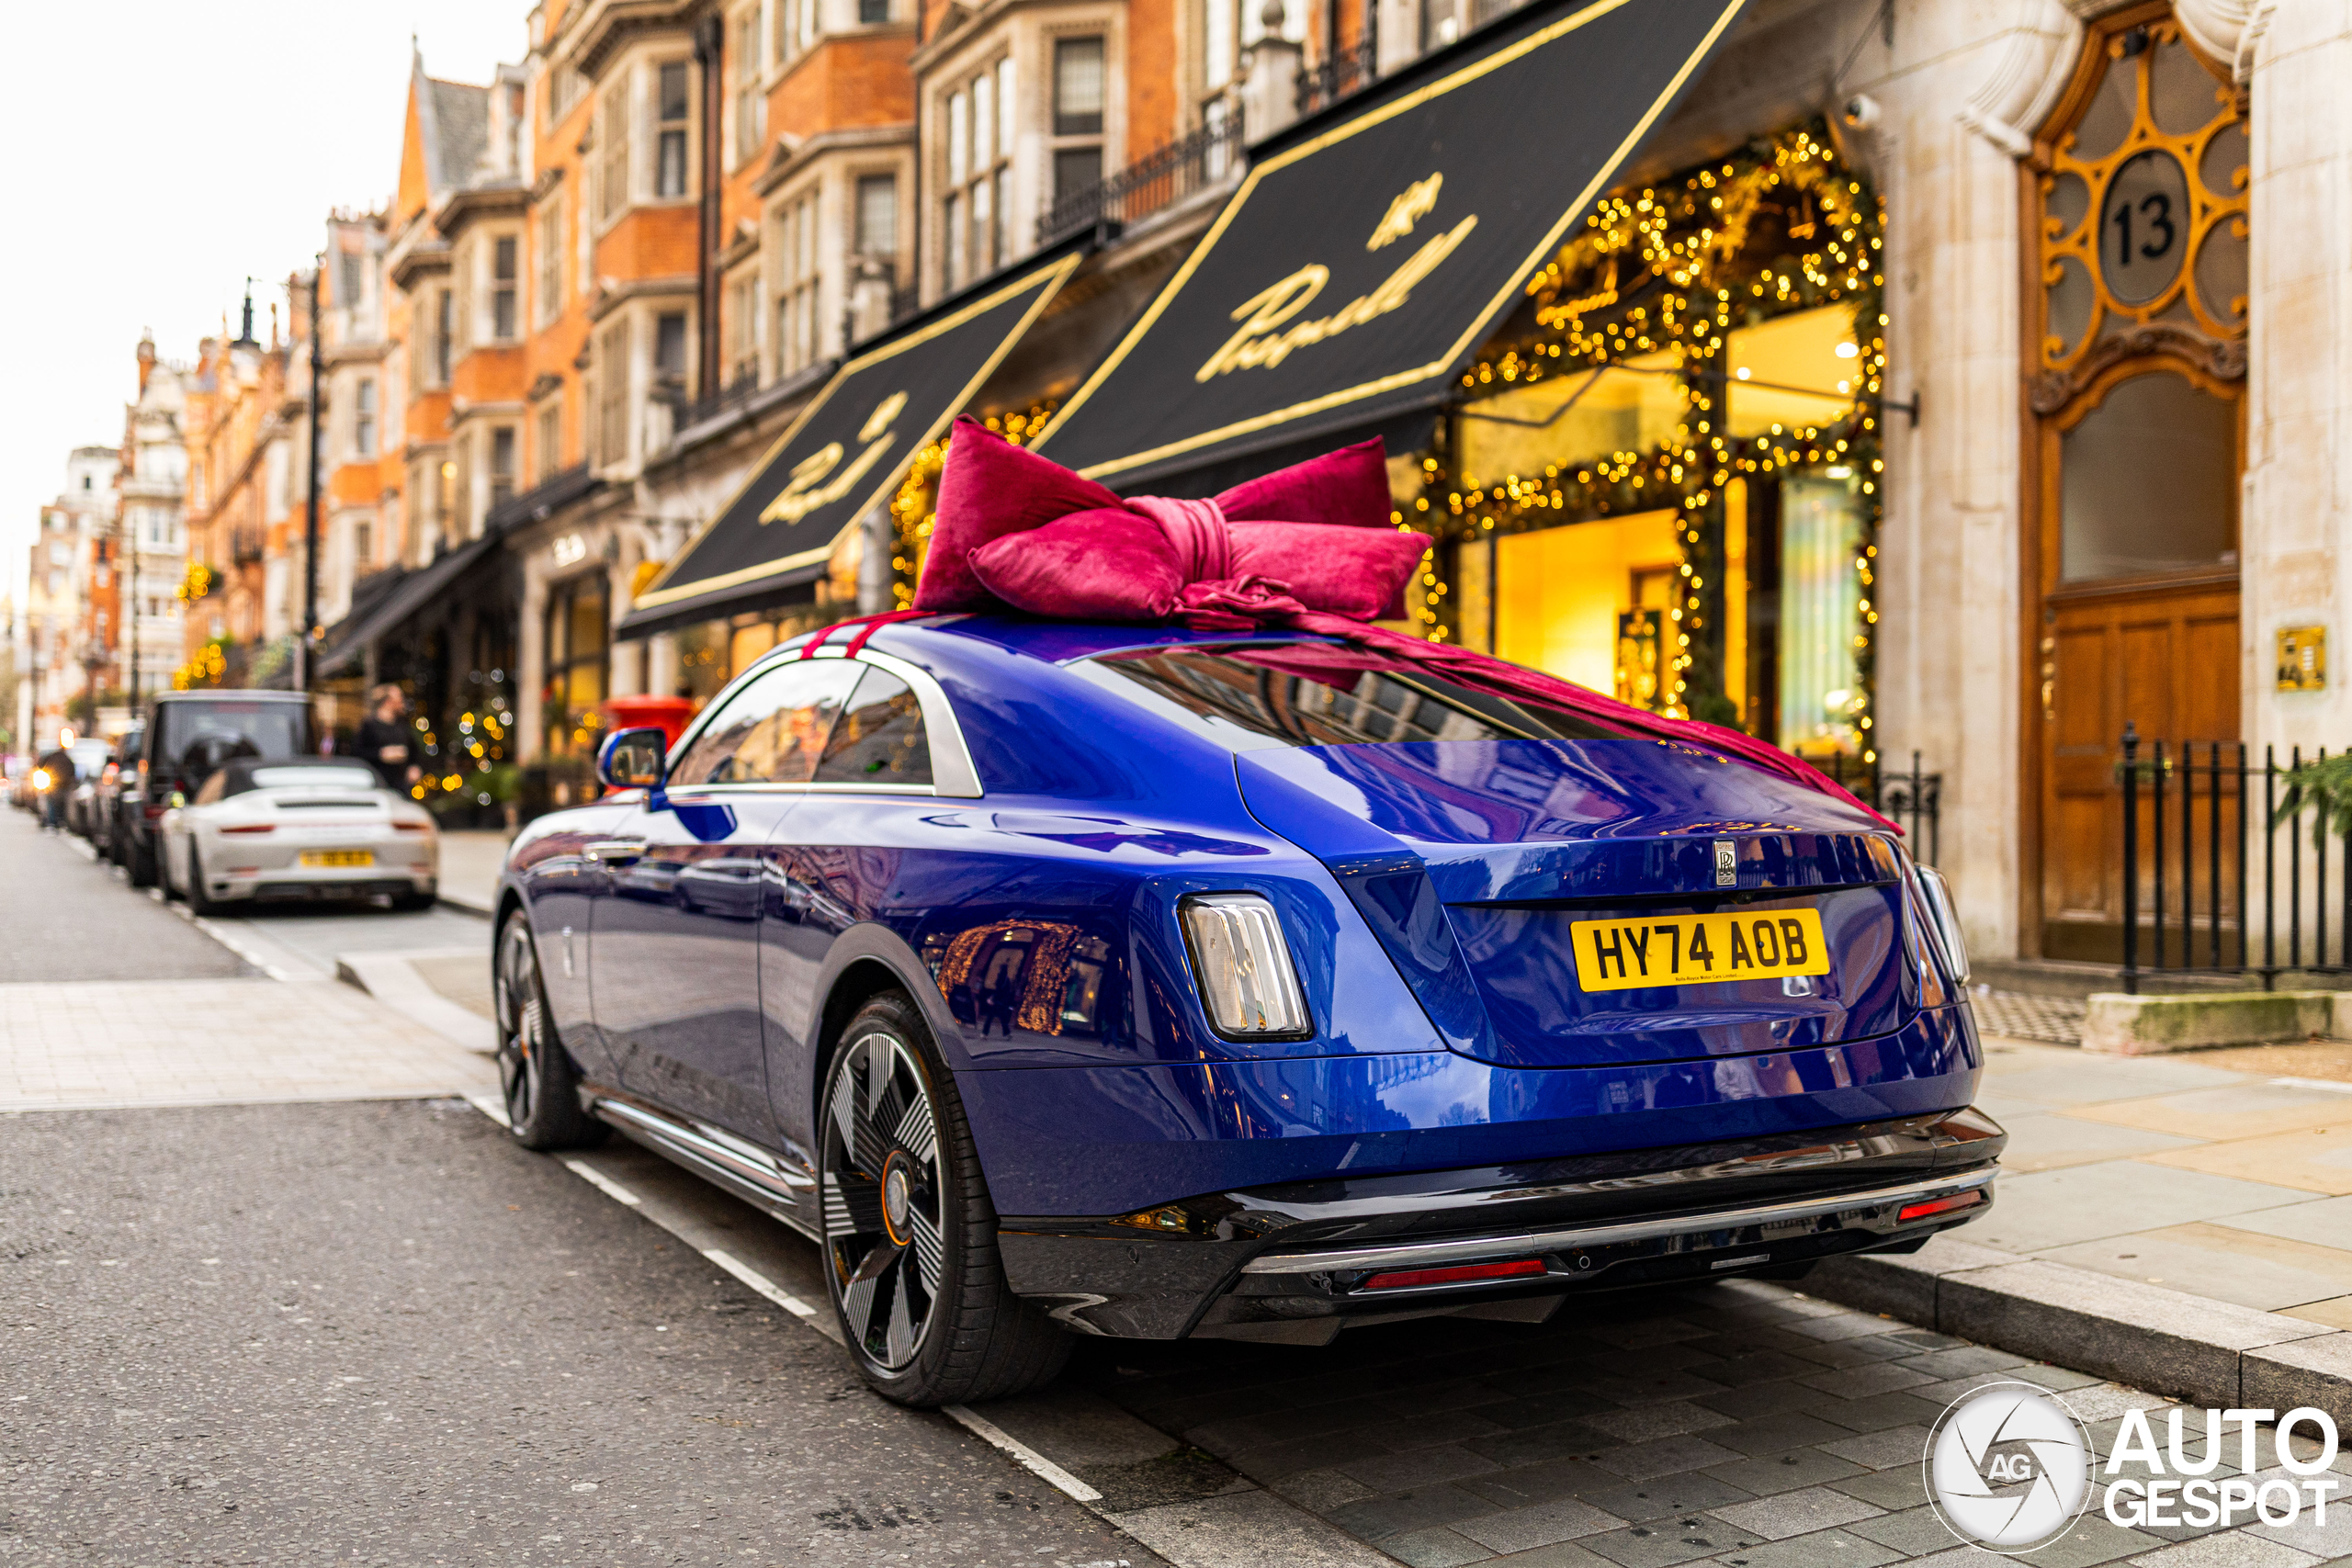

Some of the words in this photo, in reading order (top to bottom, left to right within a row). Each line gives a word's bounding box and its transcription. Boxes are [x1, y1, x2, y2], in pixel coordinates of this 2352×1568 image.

[2114, 193, 2175, 265] 13
[1593, 922, 1714, 979] HY74
[1731, 919, 1807, 970] AOB
